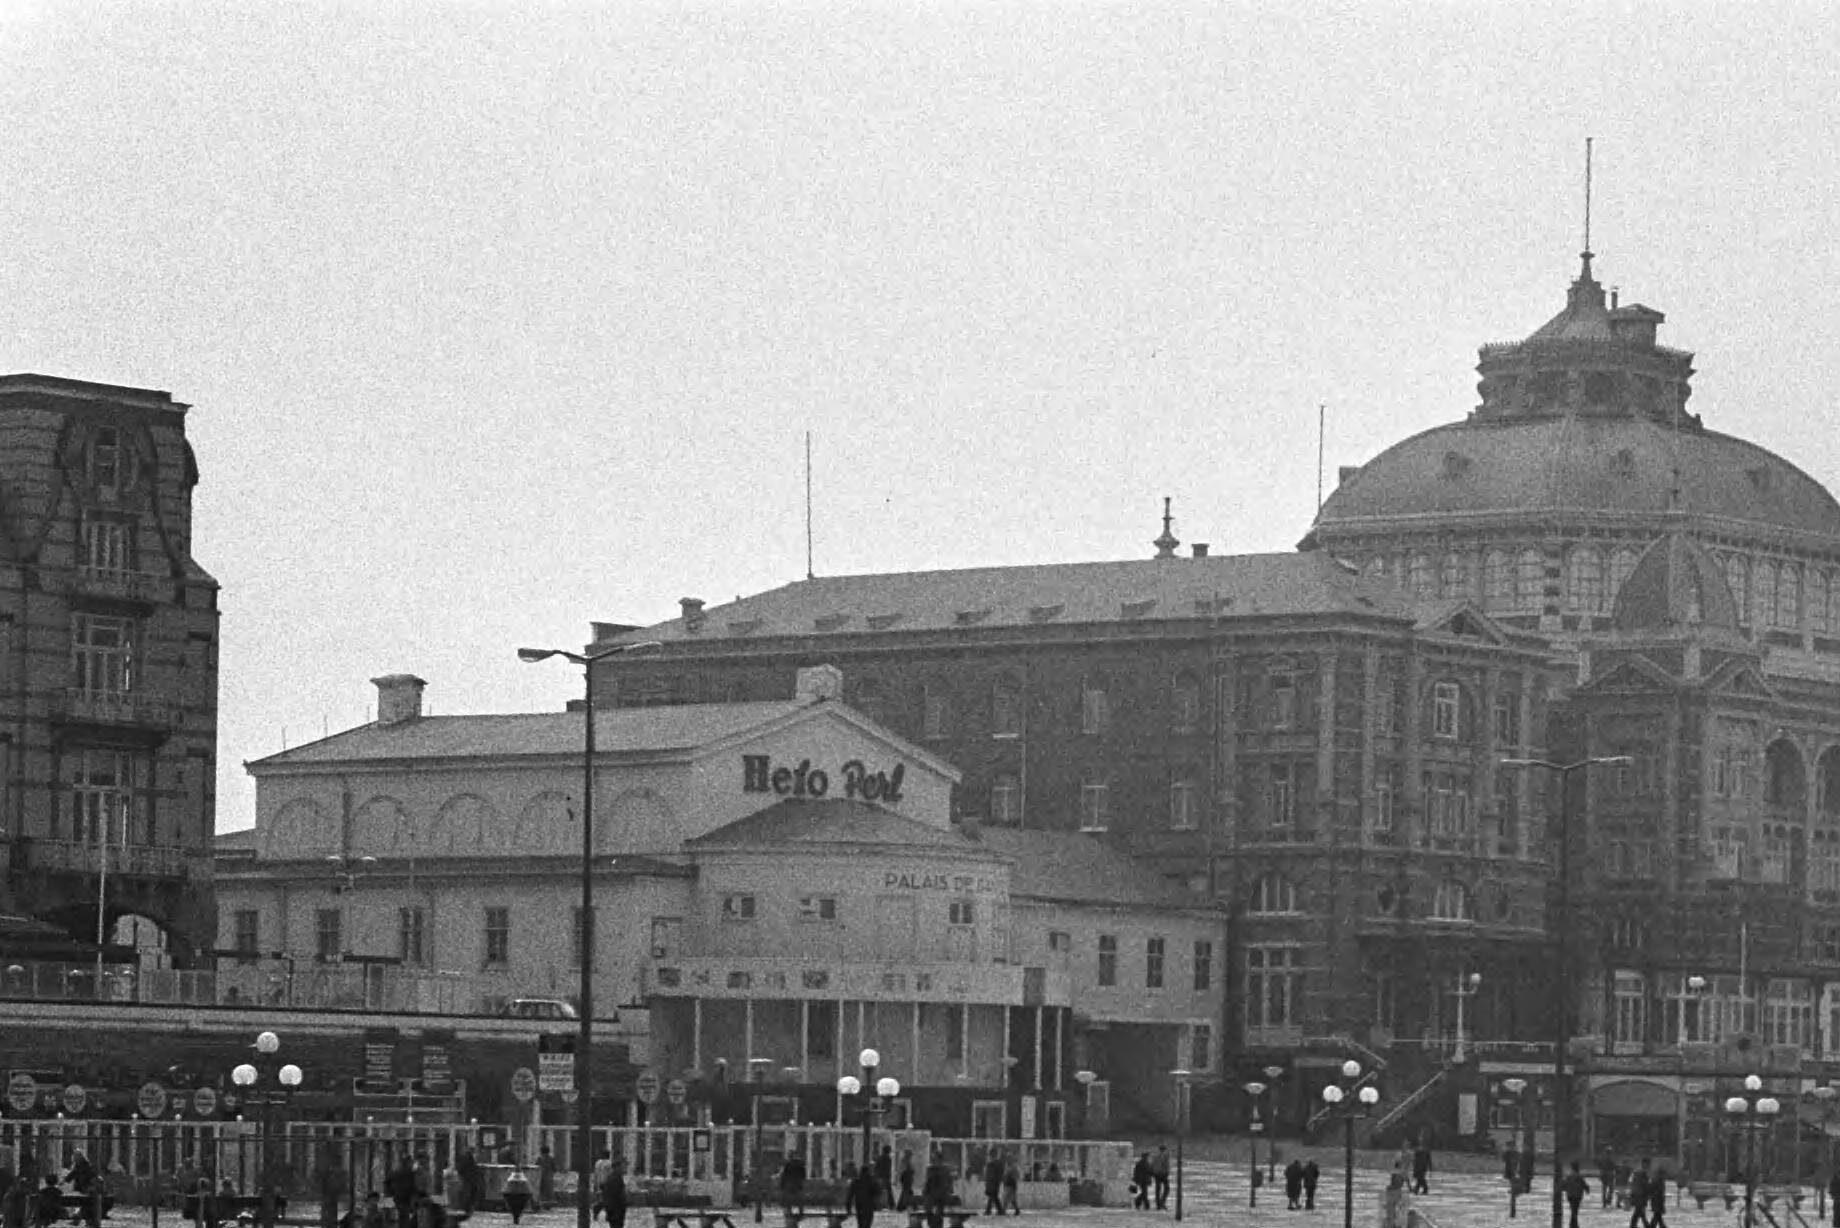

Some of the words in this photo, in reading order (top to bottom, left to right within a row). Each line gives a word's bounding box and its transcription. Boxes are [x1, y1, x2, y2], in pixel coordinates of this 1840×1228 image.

[743, 754, 829, 797] Hero
[841, 759, 905, 803] Perl
[884, 873, 948, 891] PALAIS
